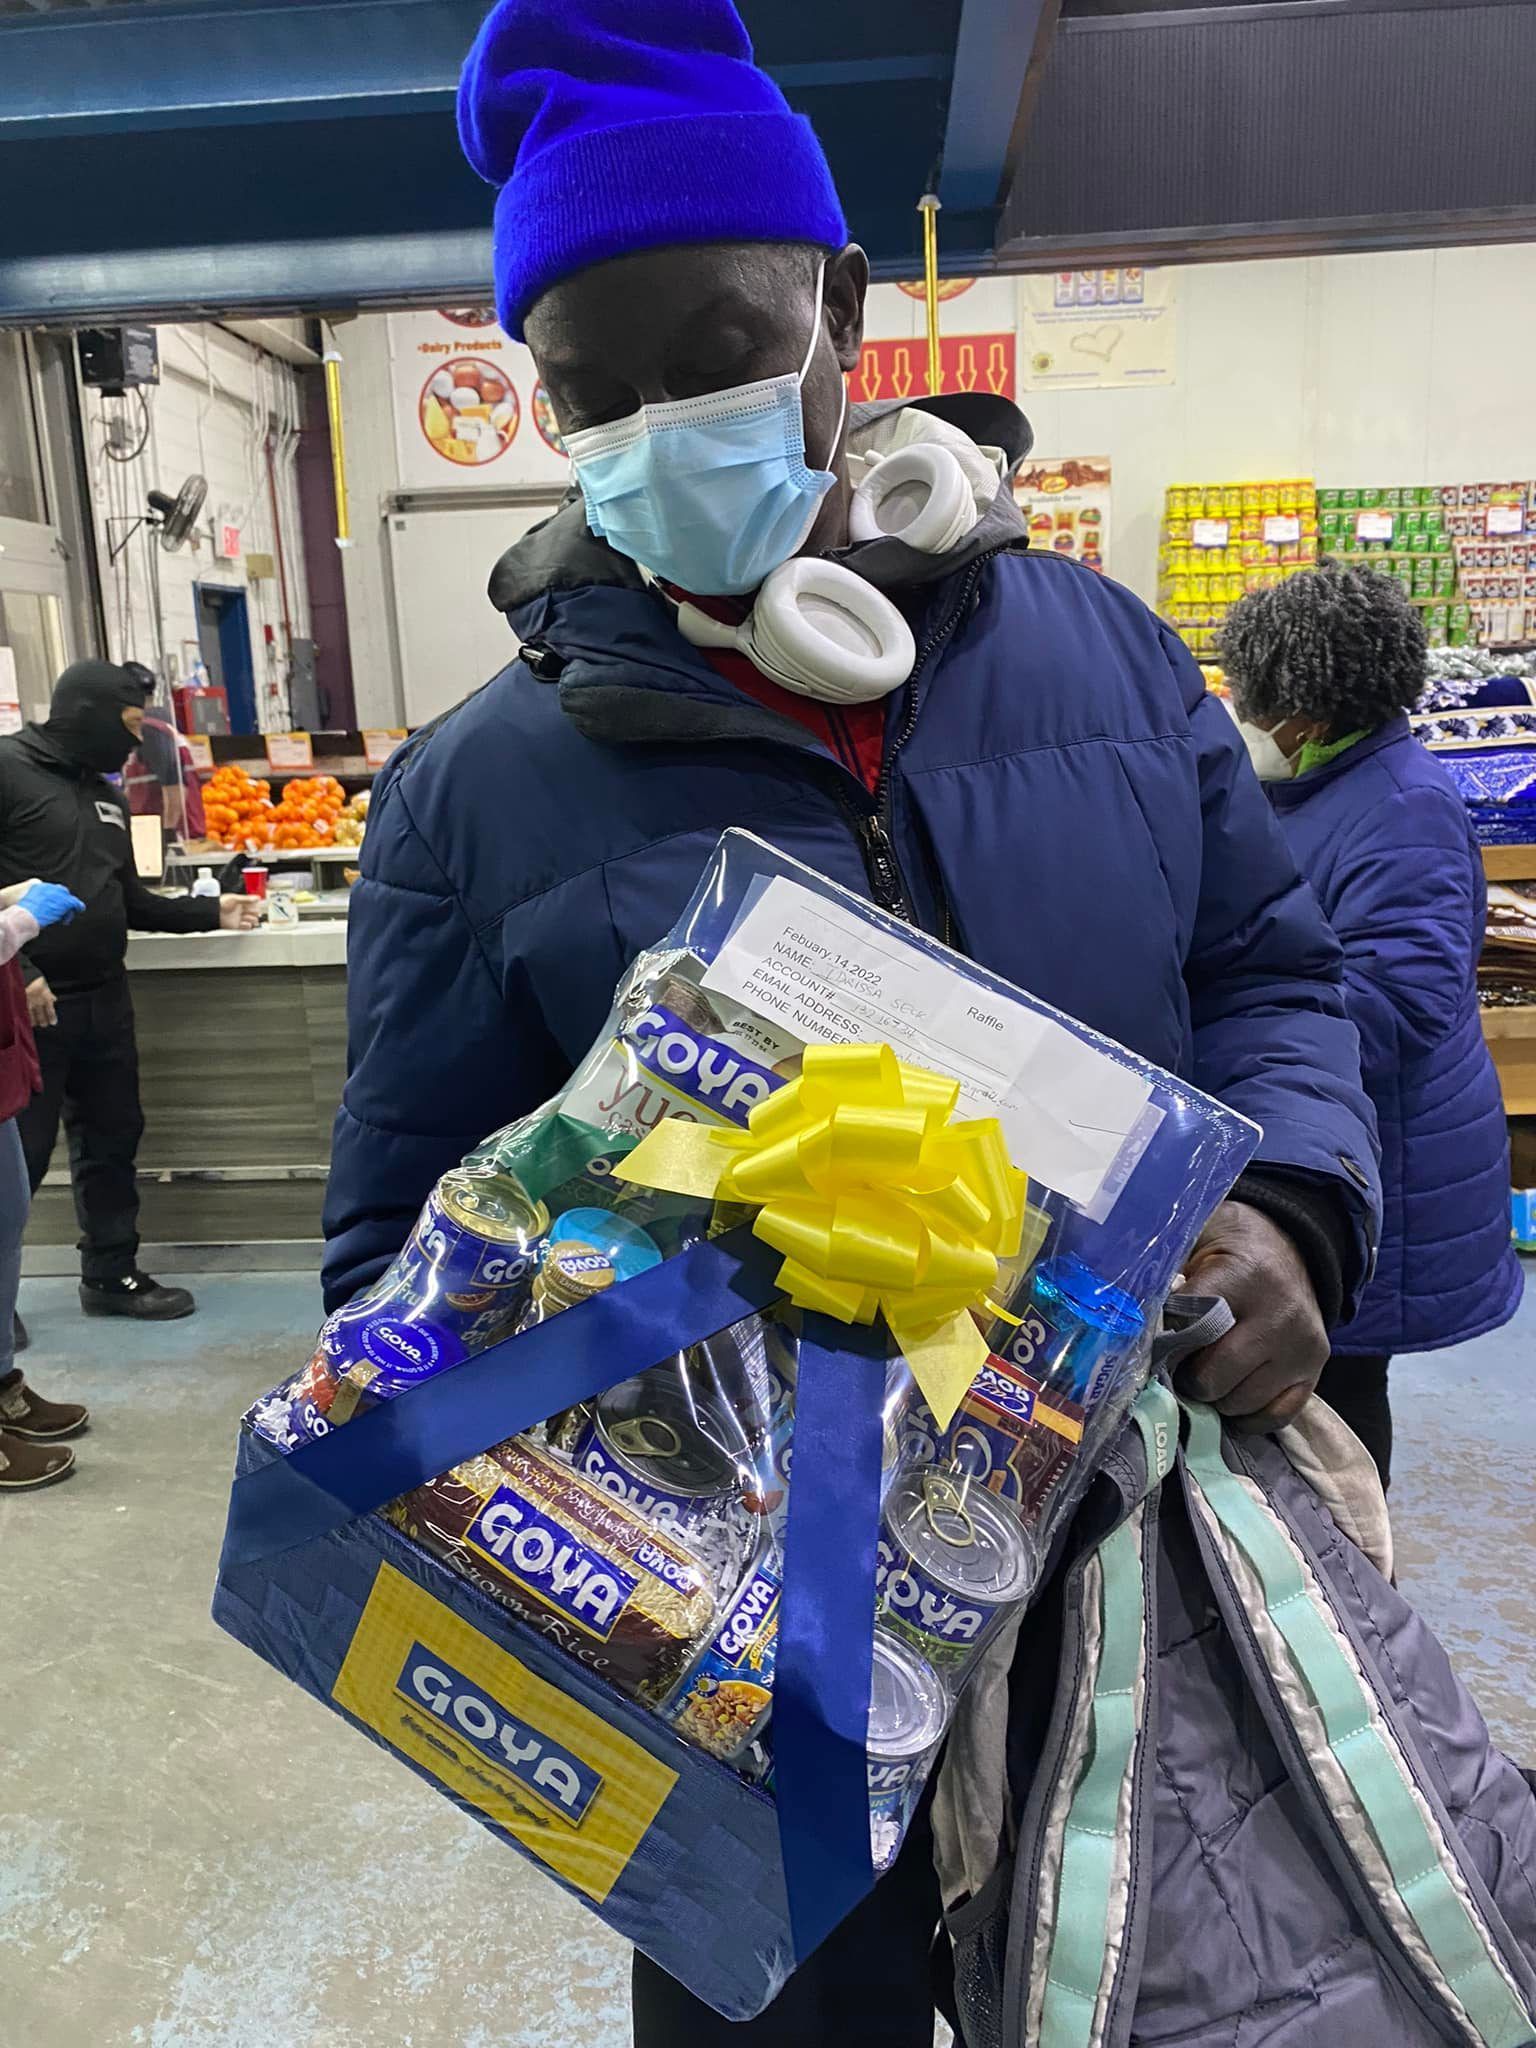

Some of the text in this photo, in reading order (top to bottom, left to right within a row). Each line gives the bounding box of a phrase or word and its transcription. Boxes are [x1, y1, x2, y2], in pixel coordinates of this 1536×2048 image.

[454, 340, 502, 351] Products
[762, 957, 836, 1001] ACCOUNT#
[773, 941, 816, 970] NAME:
[742, 981, 791, 1014] PHONE
[752, 968, 864, 1037] EMAIL ADDRESS:
[966, 1006, 1004, 1032] Raffle
[732, 1020, 762, 1037] BEST
[764, 1036, 781, 1051] BY
[626, 1012, 770, 1118] GOYA
[379, 1327, 421, 1359] GOYA
[1153, 1422, 1168, 1477] LOAD
[481, 1503, 620, 1625] GOYA
[443, 1543, 610, 1670] Brown Rice
[719, 1579, 774, 1656] GOYA
[412, 1665, 581, 1807] GOYA
